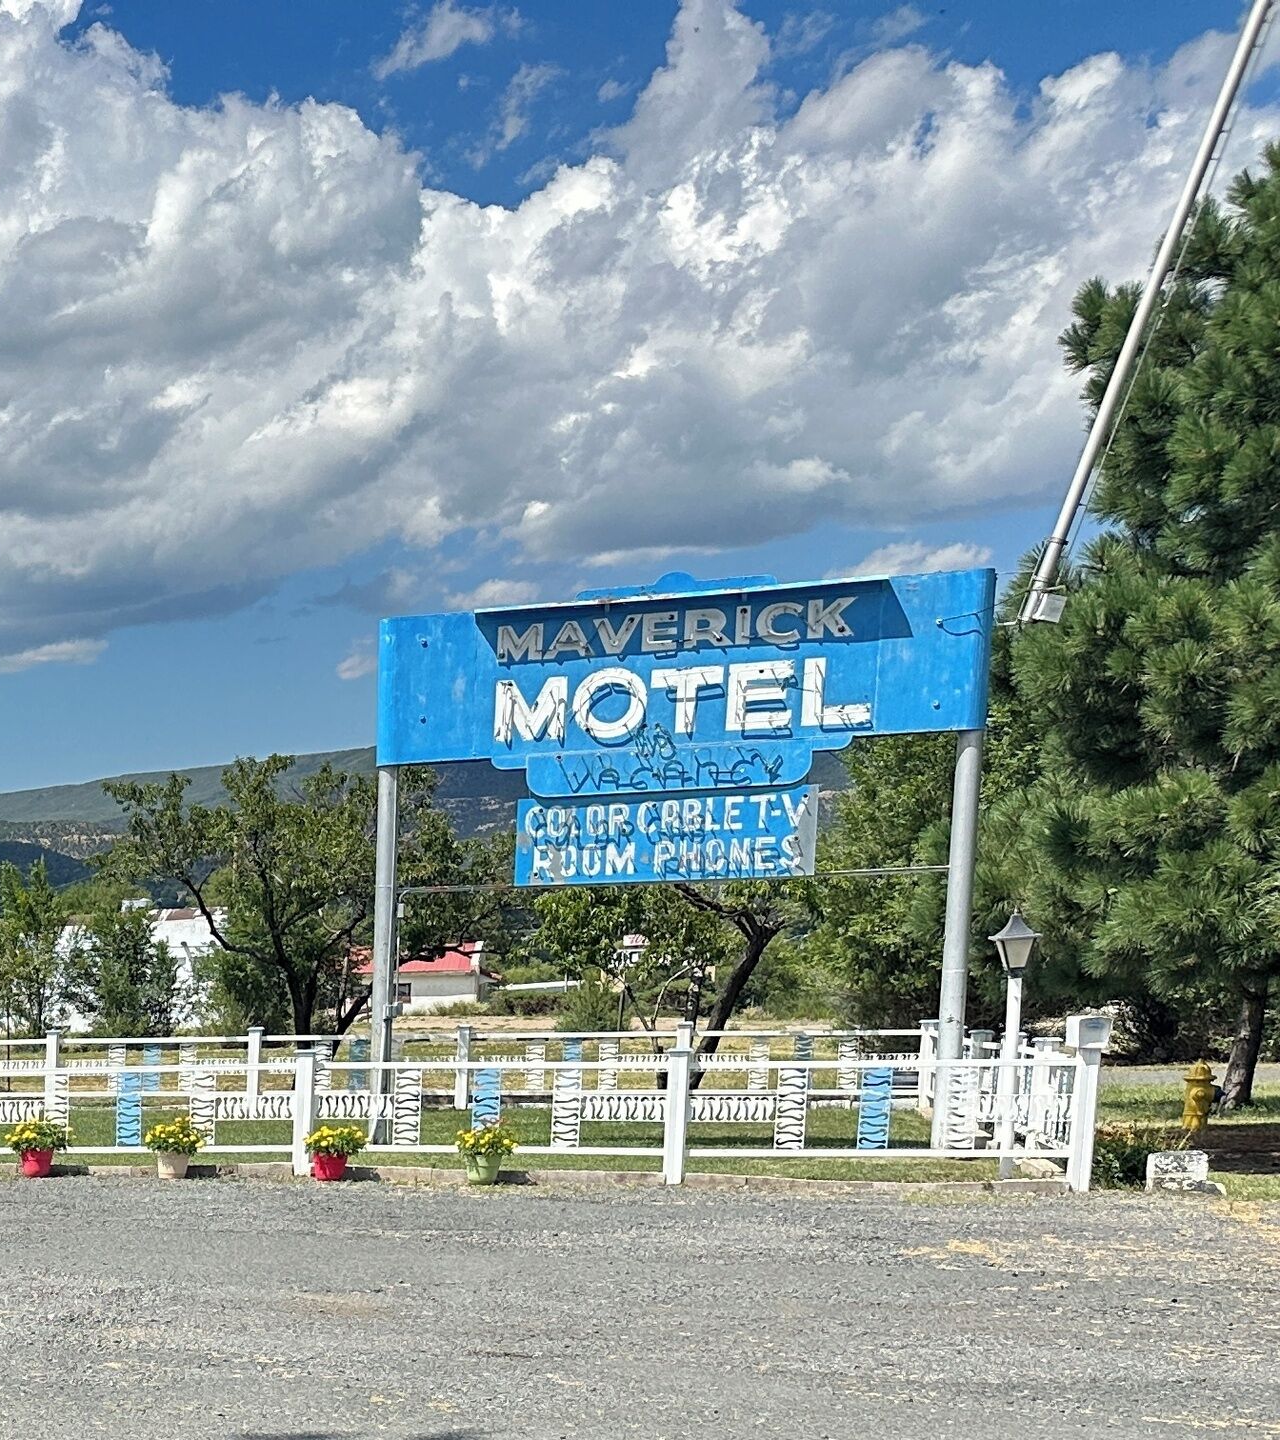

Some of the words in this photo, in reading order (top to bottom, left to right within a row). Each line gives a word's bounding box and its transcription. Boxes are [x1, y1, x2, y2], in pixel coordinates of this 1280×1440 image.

[496, 596, 858, 664] MAVERICK
[494, 657, 872, 743] MOTEL
[525, 803, 630, 838] COLOR
[637, 795, 742, 834] CABLE
[533, 841, 636, 879] ROOM
[653, 834, 803, 875] PHONES
